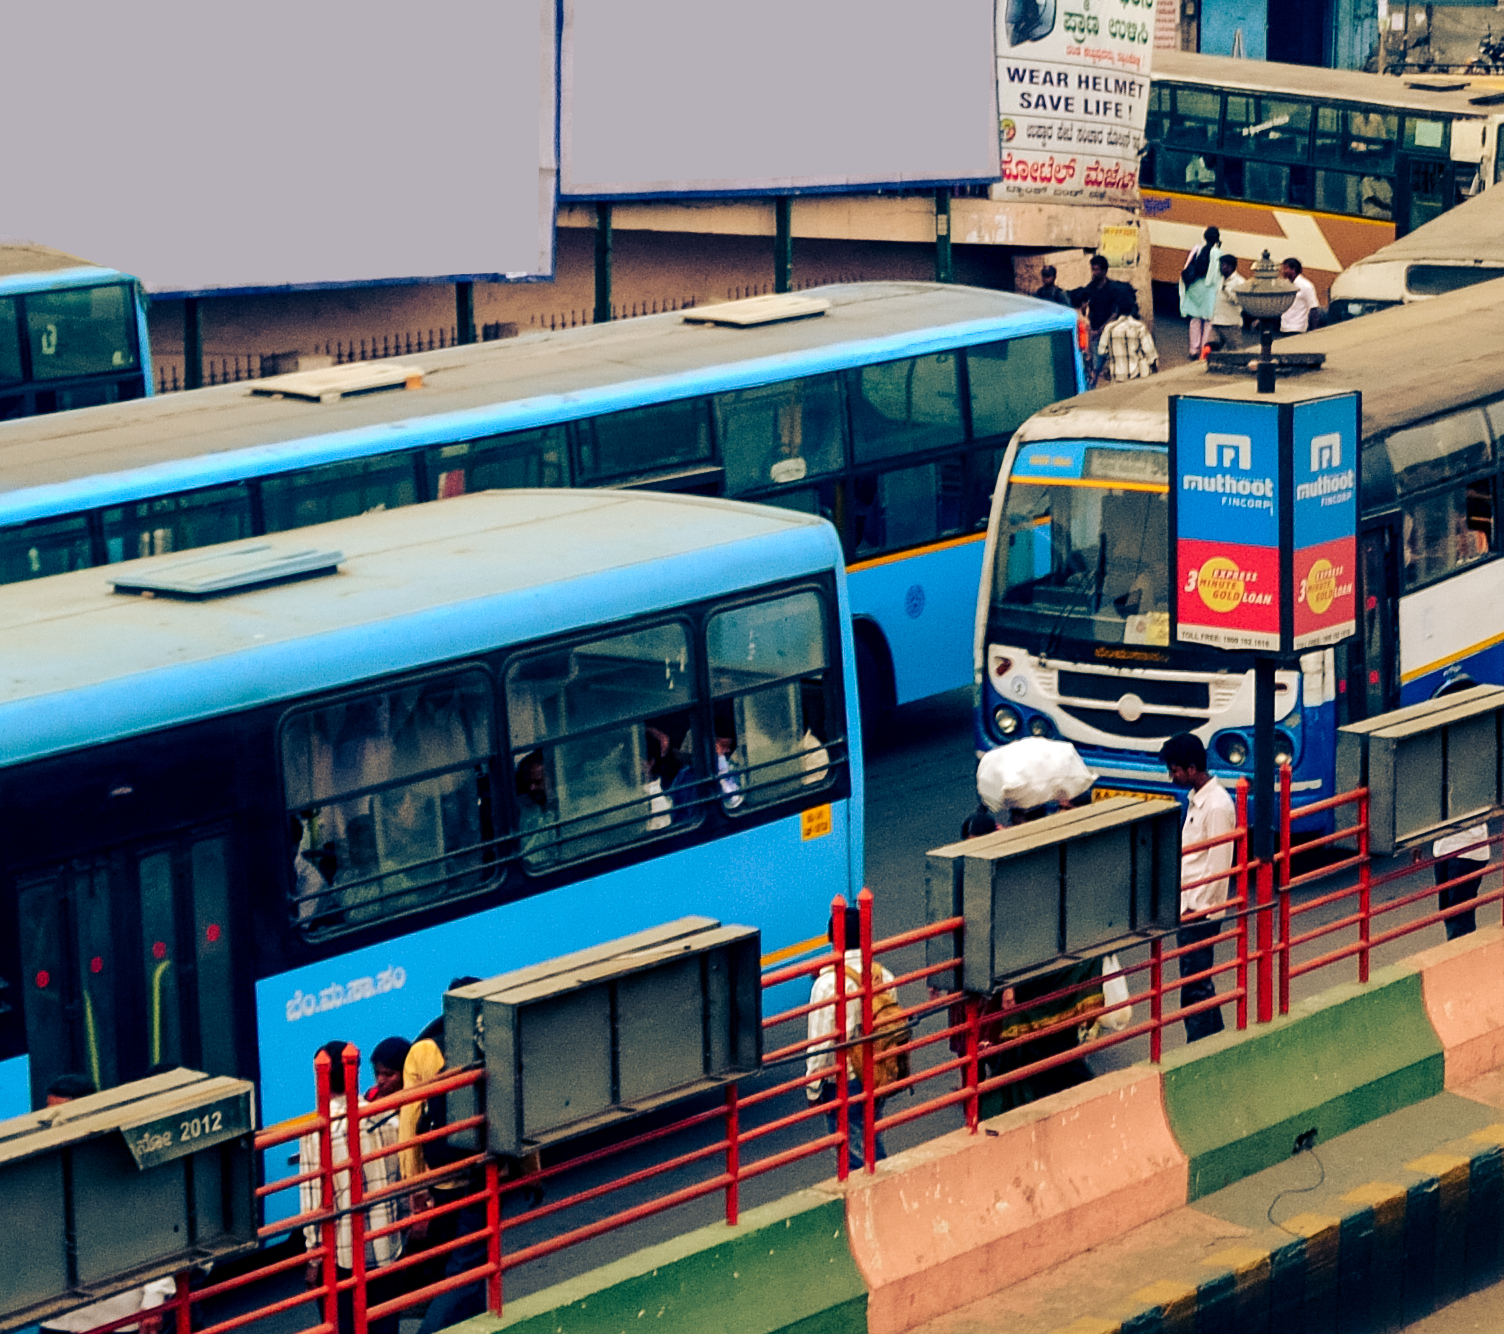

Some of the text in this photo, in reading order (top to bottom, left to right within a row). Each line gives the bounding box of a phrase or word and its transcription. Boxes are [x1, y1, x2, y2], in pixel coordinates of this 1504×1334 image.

[1007, 67, 1145, 99] WEAR HELMET
[1019, 92, 1075, 114] SAVE
[1084, 98, 1123, 119] LIFE
[1183, 474, 1273, 498] muthoot
[1296, 469, 1354, 501] muthoot
[1222, 497, 1272, 509] FINCORP
[1321, 492, 1352, 507] FINCORP
[1184, 570, 1237, 592] 3 MINUTE
[1212, 569, 1257, 582] EXPRESS
[1213, 590, 1272, 605] GOLD LOAN
[1298, 579, 1307, 603] 3
[179, 1111, 223, 1142] 2012
